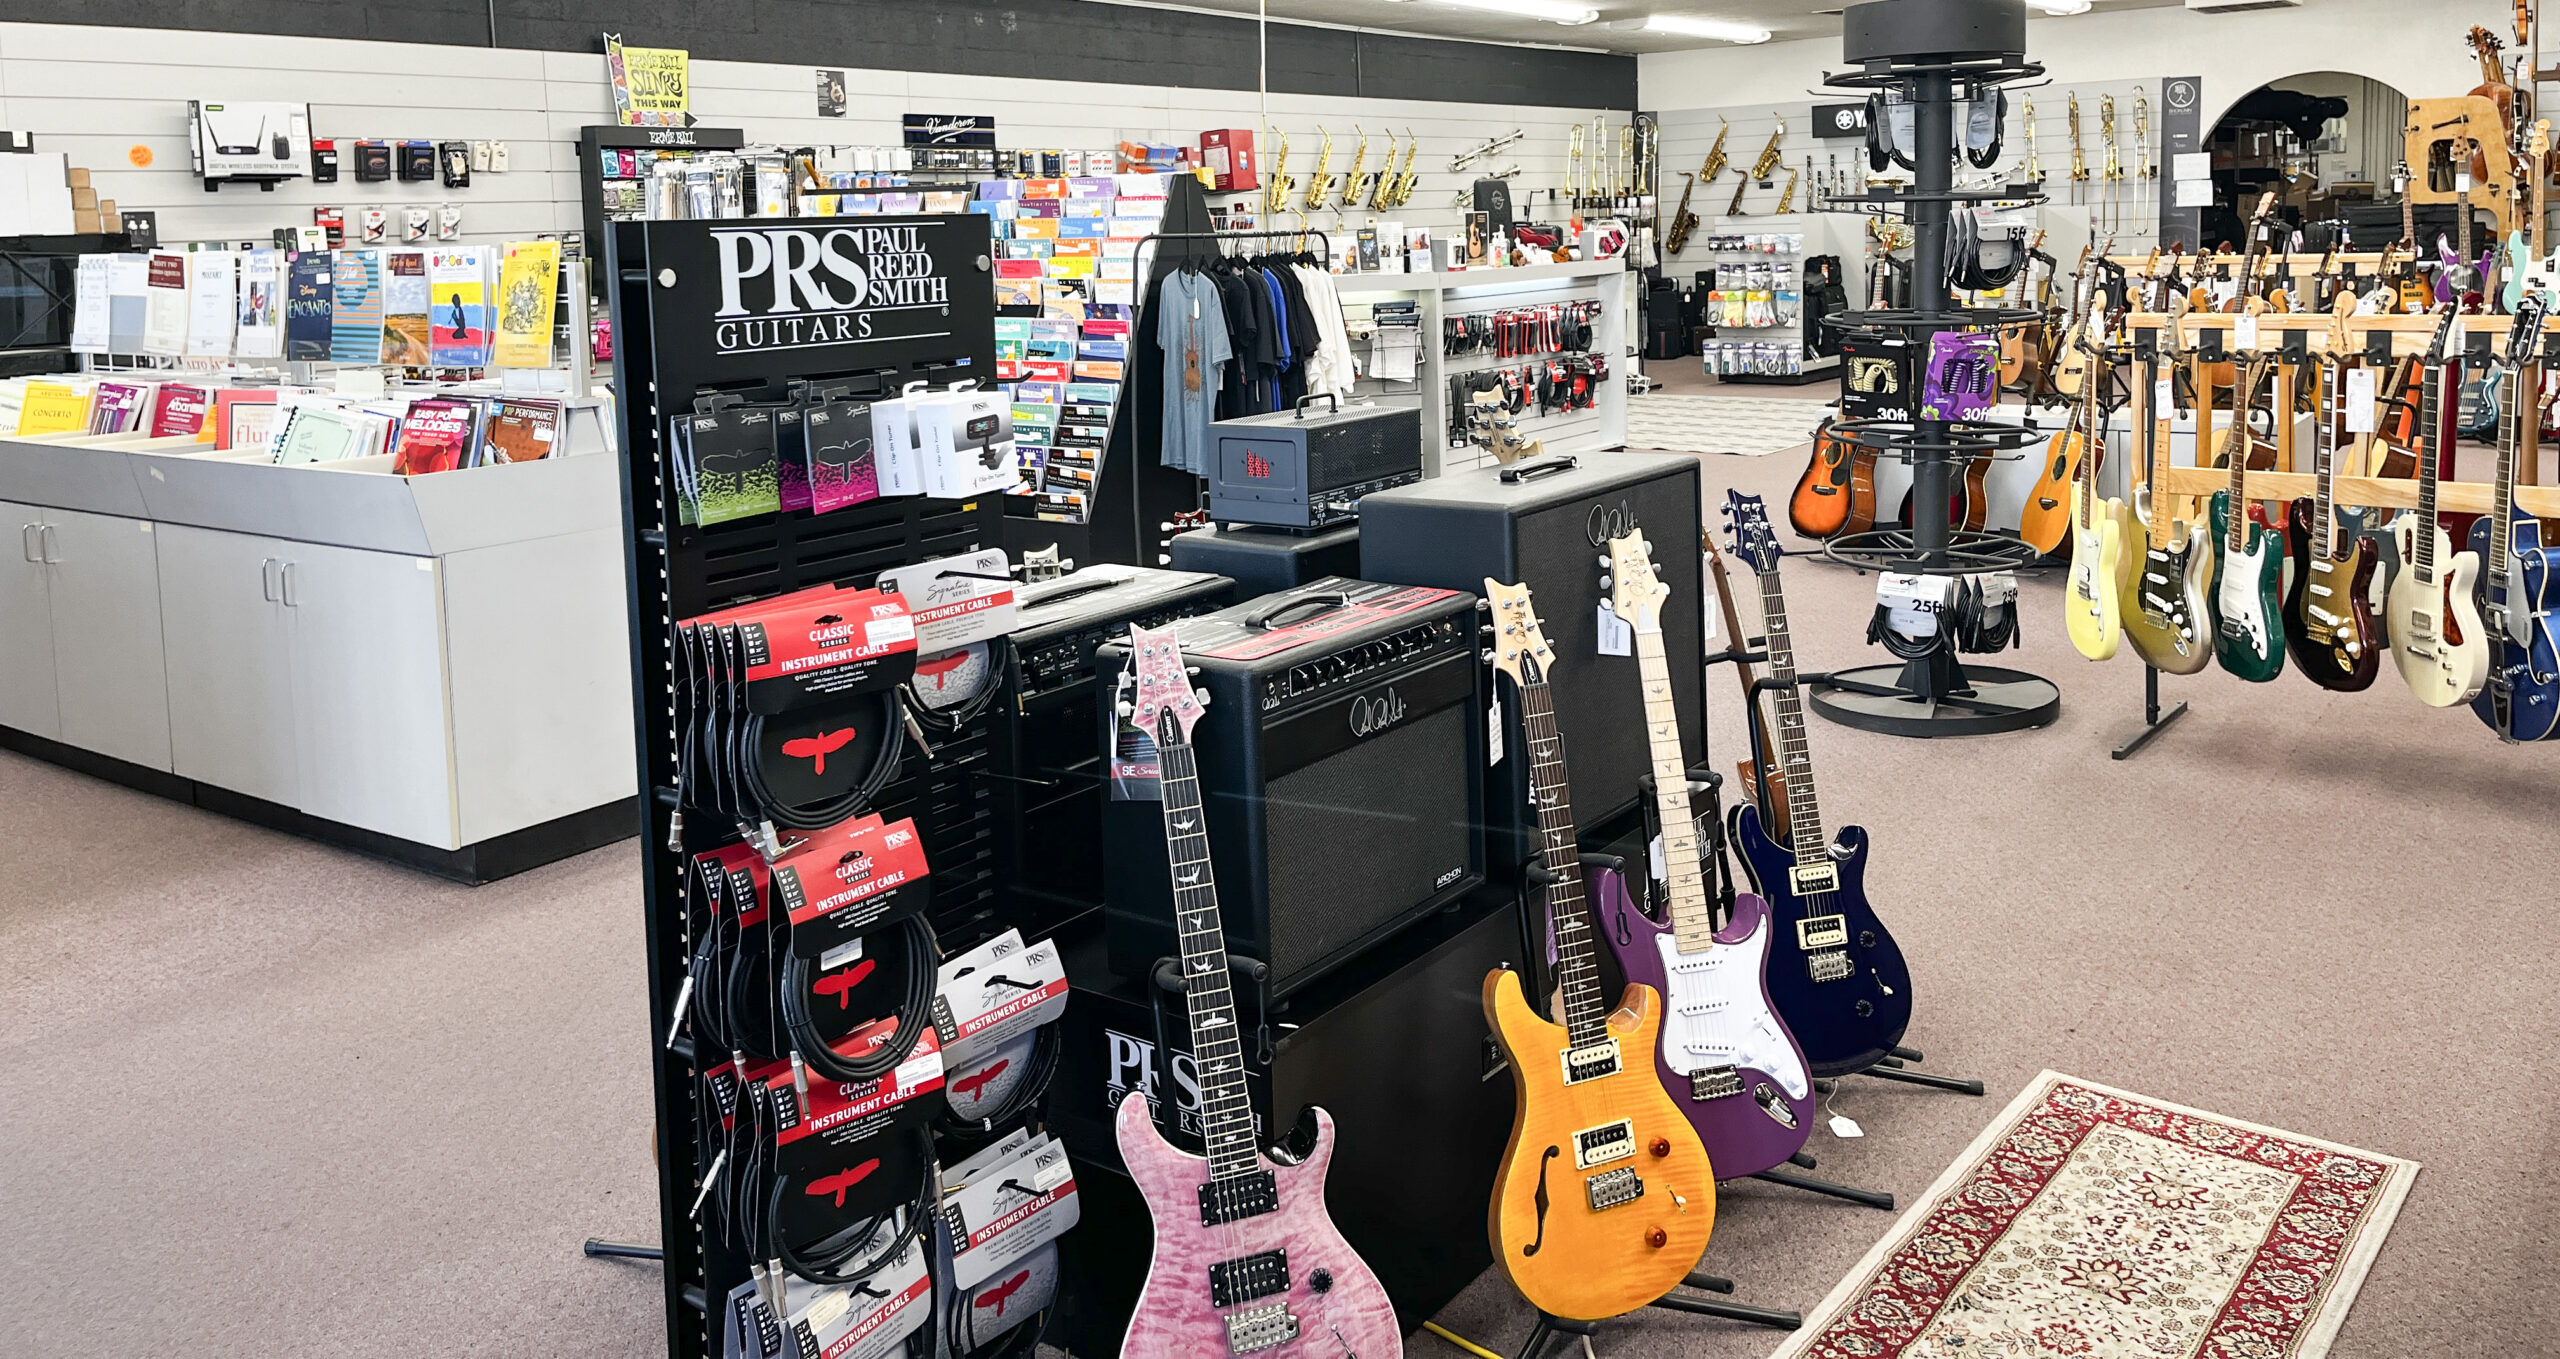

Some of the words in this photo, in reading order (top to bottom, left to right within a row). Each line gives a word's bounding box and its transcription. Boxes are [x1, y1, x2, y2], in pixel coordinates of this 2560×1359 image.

[628, 52, 659, 69] ERNIE
[660, 55, 682, 70] BALL
[631, 69, 683, 97] SLINKY
[634, 98, 658, 108] THIS
[661, 100, 682, 109] WAY
[649, 129, 677, 143] ERNIE
[677, 131, 696, 144] BALL
[925, 116, 976, 141] Vandoren
[866, 227, 926, 254] PAUL
[710, 229, 869, 317] PRS
[867, 252, 933, 280] REED
[868, 277, 949, 307] SMITH
[288, 299, 331, 319] ENCANTO
[716, 313, 872, 349] GUITARS
[33, 408, 72, 419] CONCERTO
[414, 409, 438, 419] EASY
[504, 406, 515, 415] POP
[515, 407, 554, 421] PERFORMANCE
[1877, 408, 1908, 421] 30ft
[1962, 407, 1990, 421] 30ft
[236, 424, 269, 444] flut
[404, 418, 462, 434] MELODIES
[531, 420, 553, 430] PIECES
[976, 558, 992, 569] PRS
[911, 602, 966, 624] NSTRUMENT
[967, 597, 993, 611] CABLE
[1912, 598, 1945, 613] 25ft
[809, 624, 855, 642] CLASSIC
[820, 638, 848, 648] SERIES
[781, 648, 854, 672] INSTRUMENT
[855, 643, 890, 657] CABLE
[794, 671, 819, 681] QUALITY
[840, 663, 862, 672] QUALITY
[1166, 715, 1174, 742] Custom
[1122, 765, 1137, 777] SE
[1136, 765, 1160, 776] Serie
[835, 856, 874, 879] CLASSIC
[1436, 866, 1462, 885] ARCHON
[847, 870, 870, 884] SERIES
[817, 880, 876, 912] INSTRUMENT
[877, 870, 905, 889] CABLE
[829, 908, 849, 919] QUALITY
[865, 895, 885, 906] QUALITY
[991, 943, 1010, 958] PRS
[1025, 951, 1044, 966] PRS
[965, 1001, 1021, 1034] INSTRUMENT
[1021, 988, 1048, 1008] CABLE
[850, 1086, 877, 1100] SERIES
[810, 1097, 881, 1132] INSTRUMENT
[883, 1086, 917, 1105] CABLE
[822, 1124, 846, 1138] QUALITY
[866, 1110, 890, 1122] QUALITY
[1034, 1153, 1053, 1168] PRS
[976, 1206, 1030, 1243] INSTRUMENT
[1030, 1190, 1056, 1212] CABLE
[828, 1311, 884, 1359] INSTRUMENT
[884, 1291, 911, 1318] CABLE
